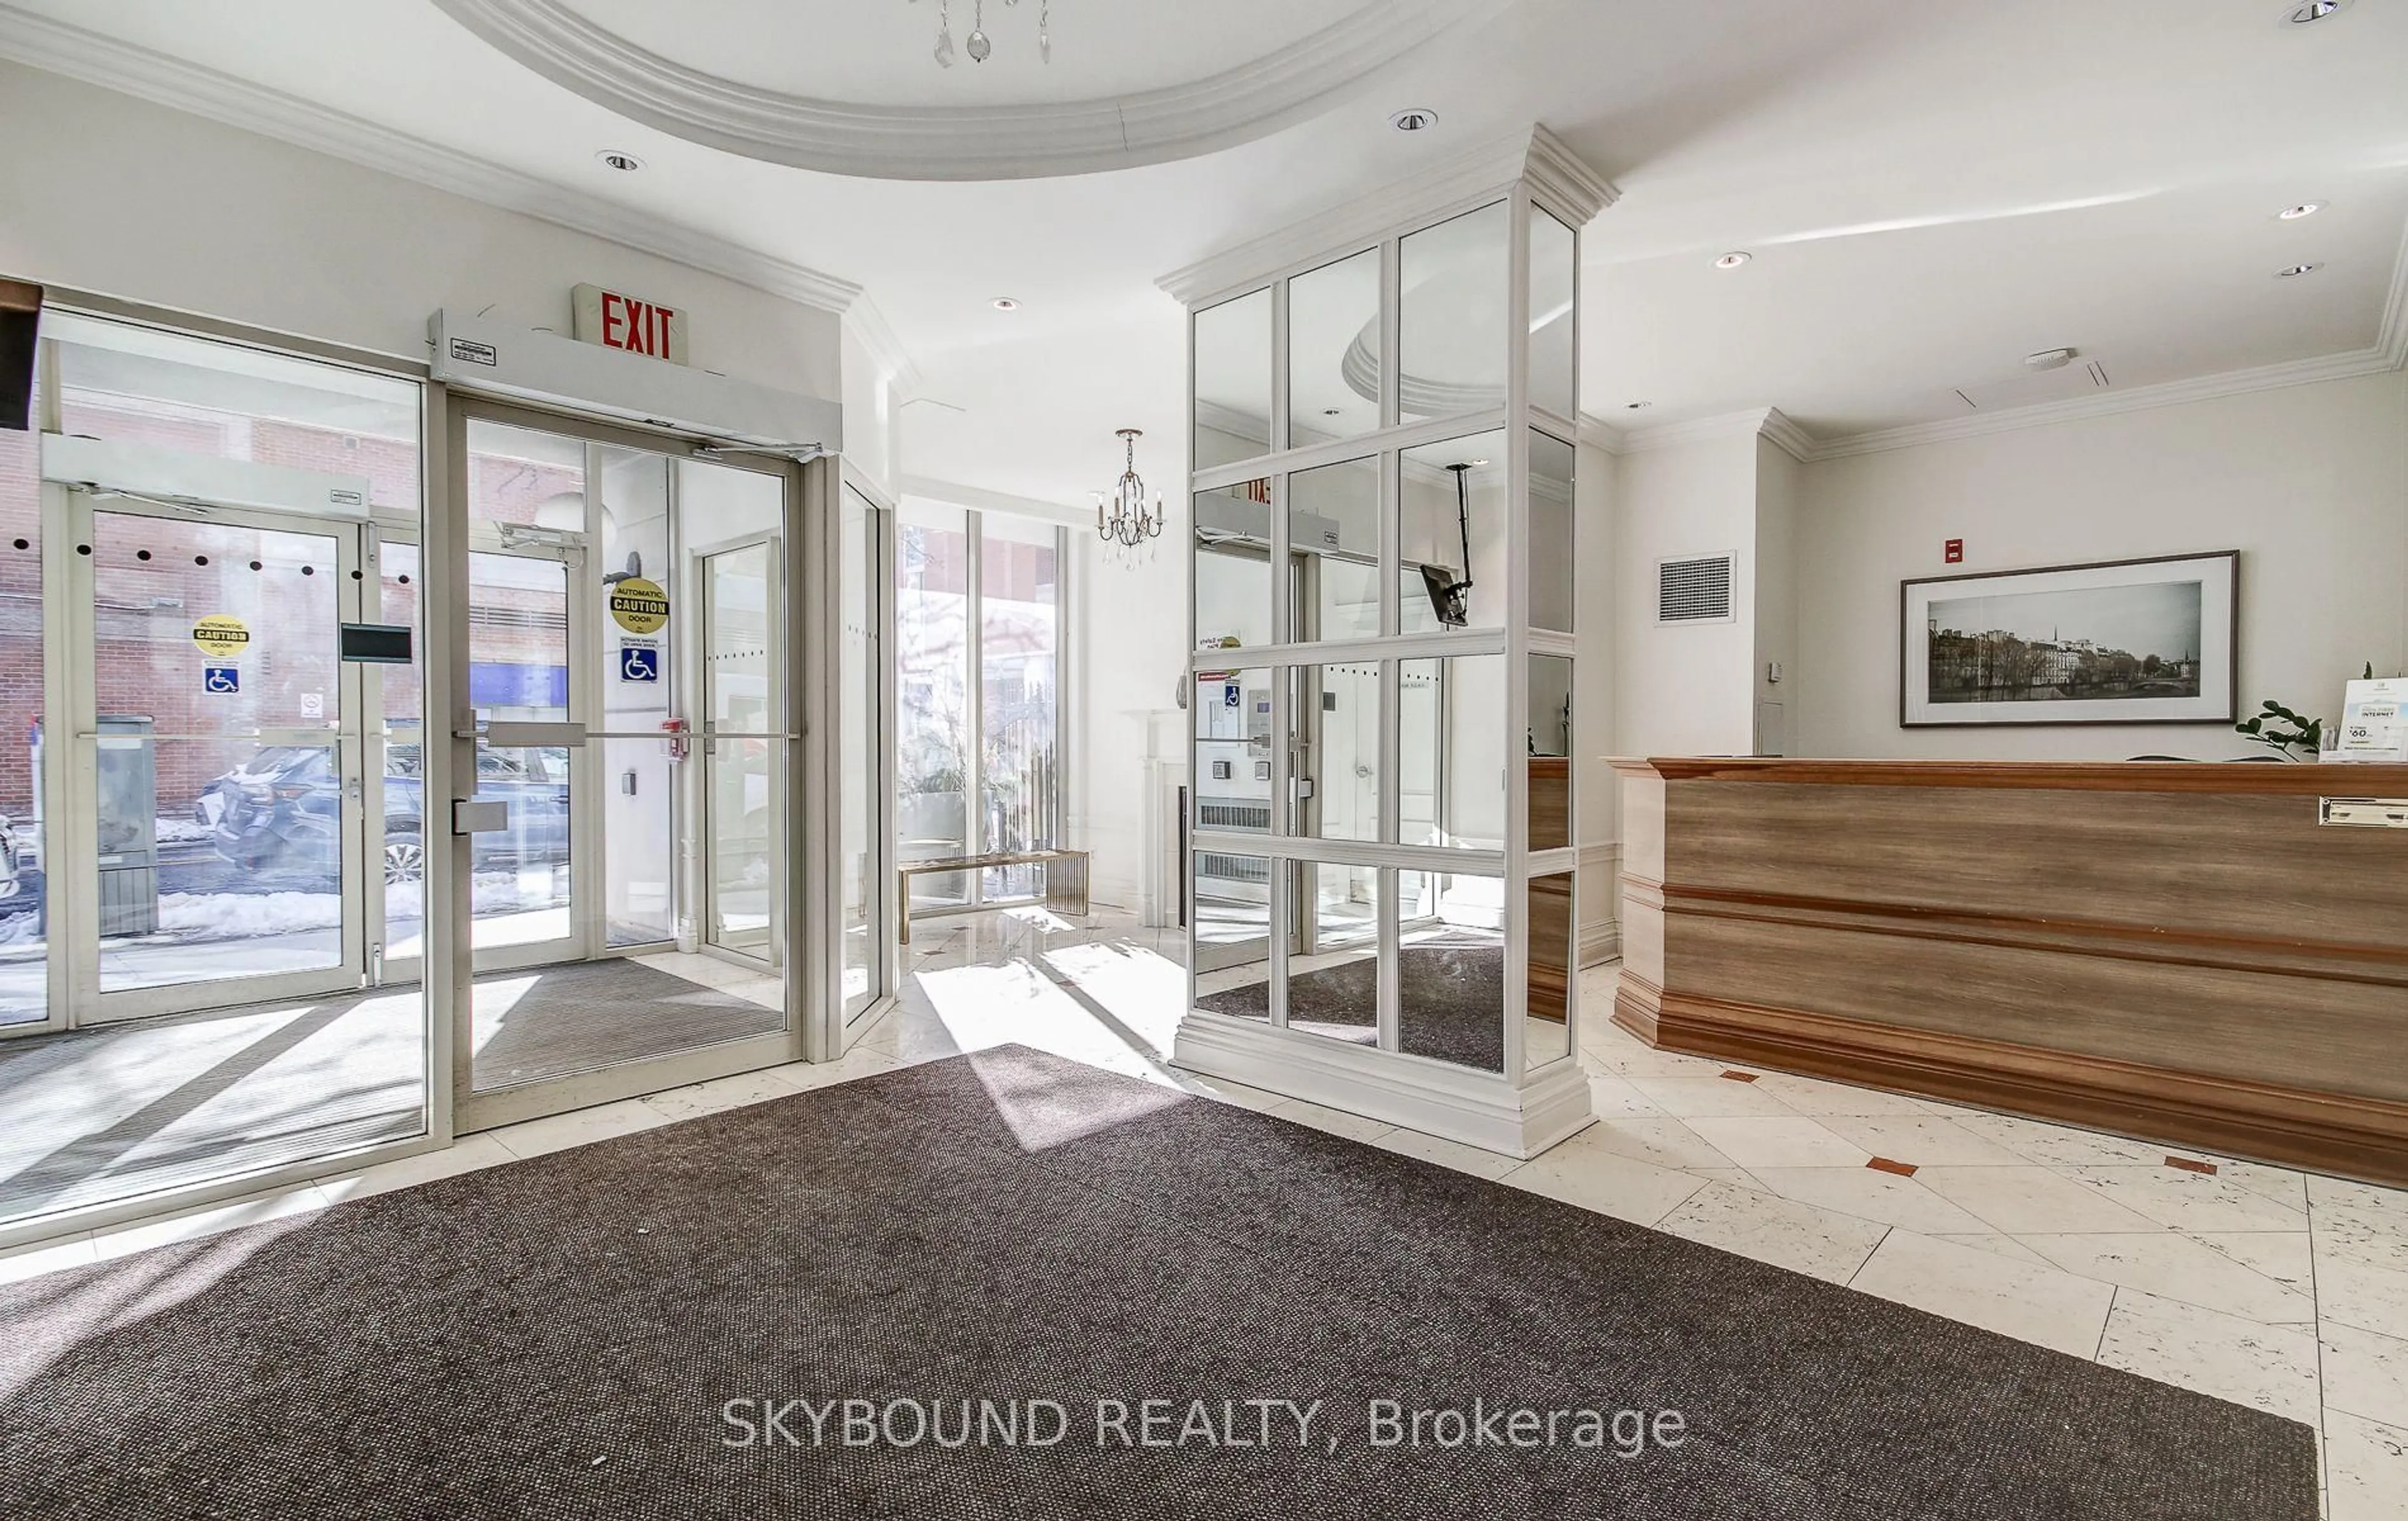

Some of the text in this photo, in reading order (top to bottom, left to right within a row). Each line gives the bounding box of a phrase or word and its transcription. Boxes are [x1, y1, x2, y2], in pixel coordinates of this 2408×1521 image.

[601, 292, 673, 360] EXIT
[617, 588, 662, 598] AUTOMATIC
[614, 598, 665, 613] CAUTION
[628, 615, 652, 623] DOOR
[196, 630, 247, 640] CAUTION
